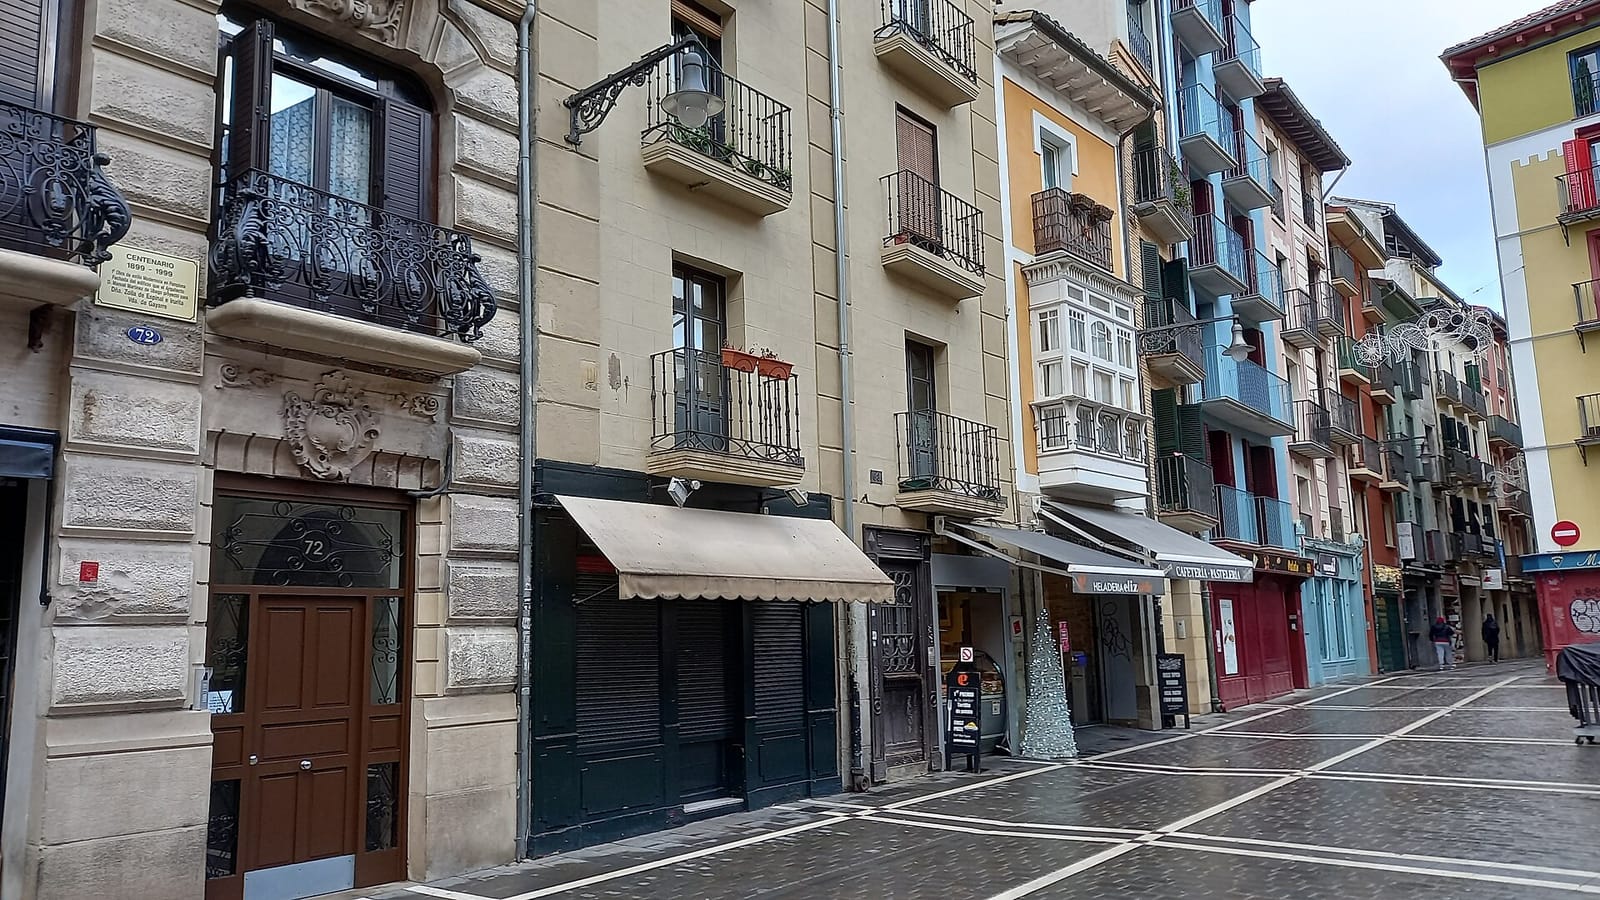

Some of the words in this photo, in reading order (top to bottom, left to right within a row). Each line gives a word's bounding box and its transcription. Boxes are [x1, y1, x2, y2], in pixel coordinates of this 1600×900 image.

[126, 254, 174, 269] CENTENARIO
[127, 262, 145, 271] 1899
[156, 268, 173, 277] 1999
[135, 328, 154, 343] 72
[304, 540, 323, 555] 72
